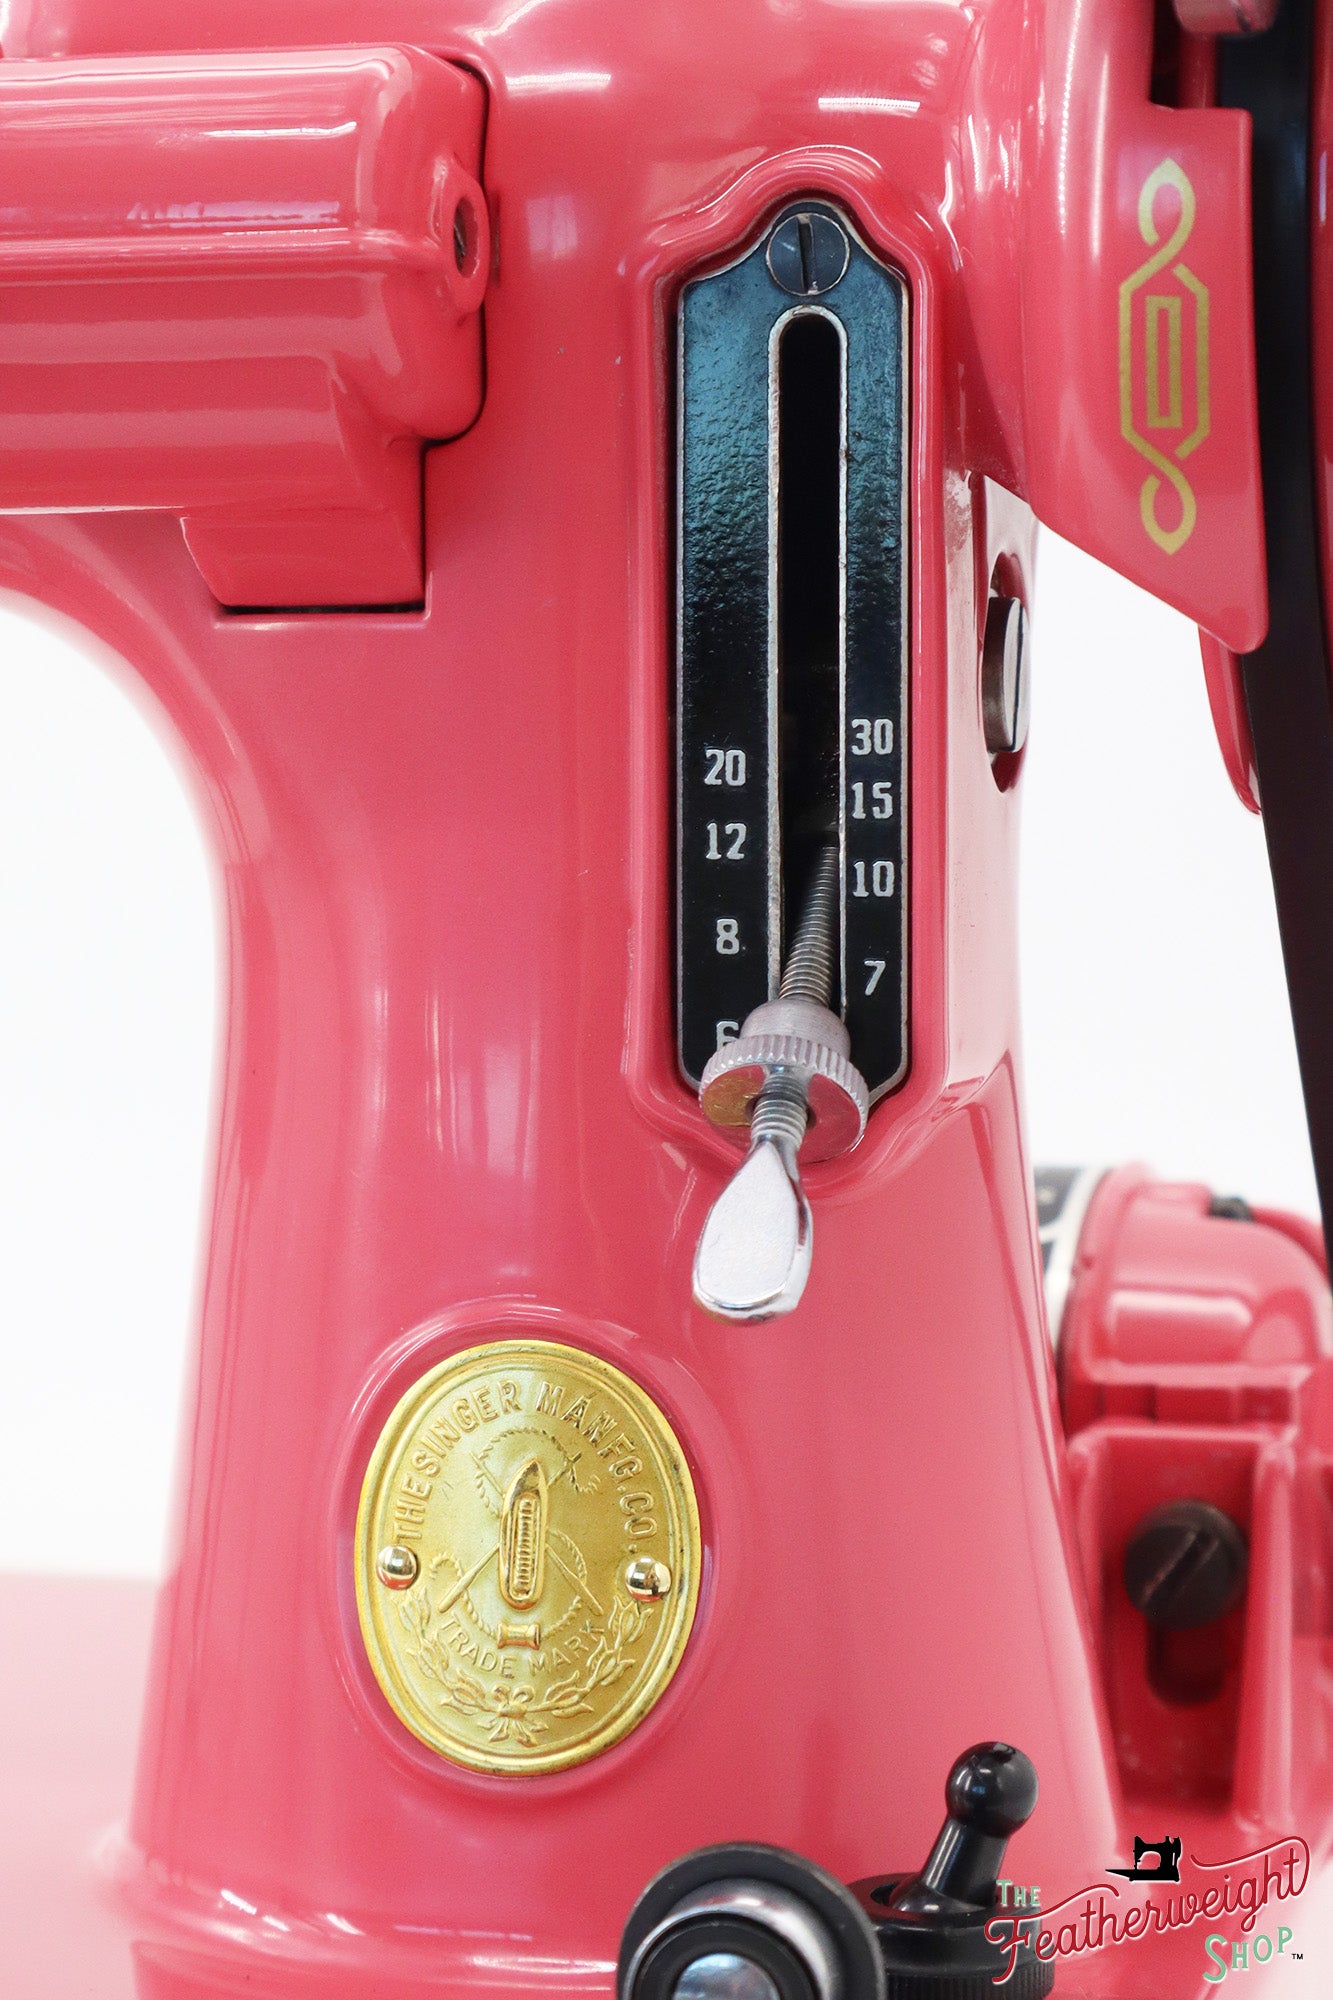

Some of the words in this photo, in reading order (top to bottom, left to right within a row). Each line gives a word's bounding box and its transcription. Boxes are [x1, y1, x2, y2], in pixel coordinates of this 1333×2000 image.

[851, 718, 894, 756] 30
[704, 749, 746, 787] 20
[851, 781, 894, 820] 15
[705, 822, 747, 860] 12
[852, 860, 895, 898] 10
[716, 918, 740, 955] 8
[863, 959, 886, 996] 7
[412, 1381, 523, 1478] SINGER
[392, 1472, 433, 1545] THE
[438, 1614, 519, 1680] TRADE
[529, 1619, 606, 1673] MARK
